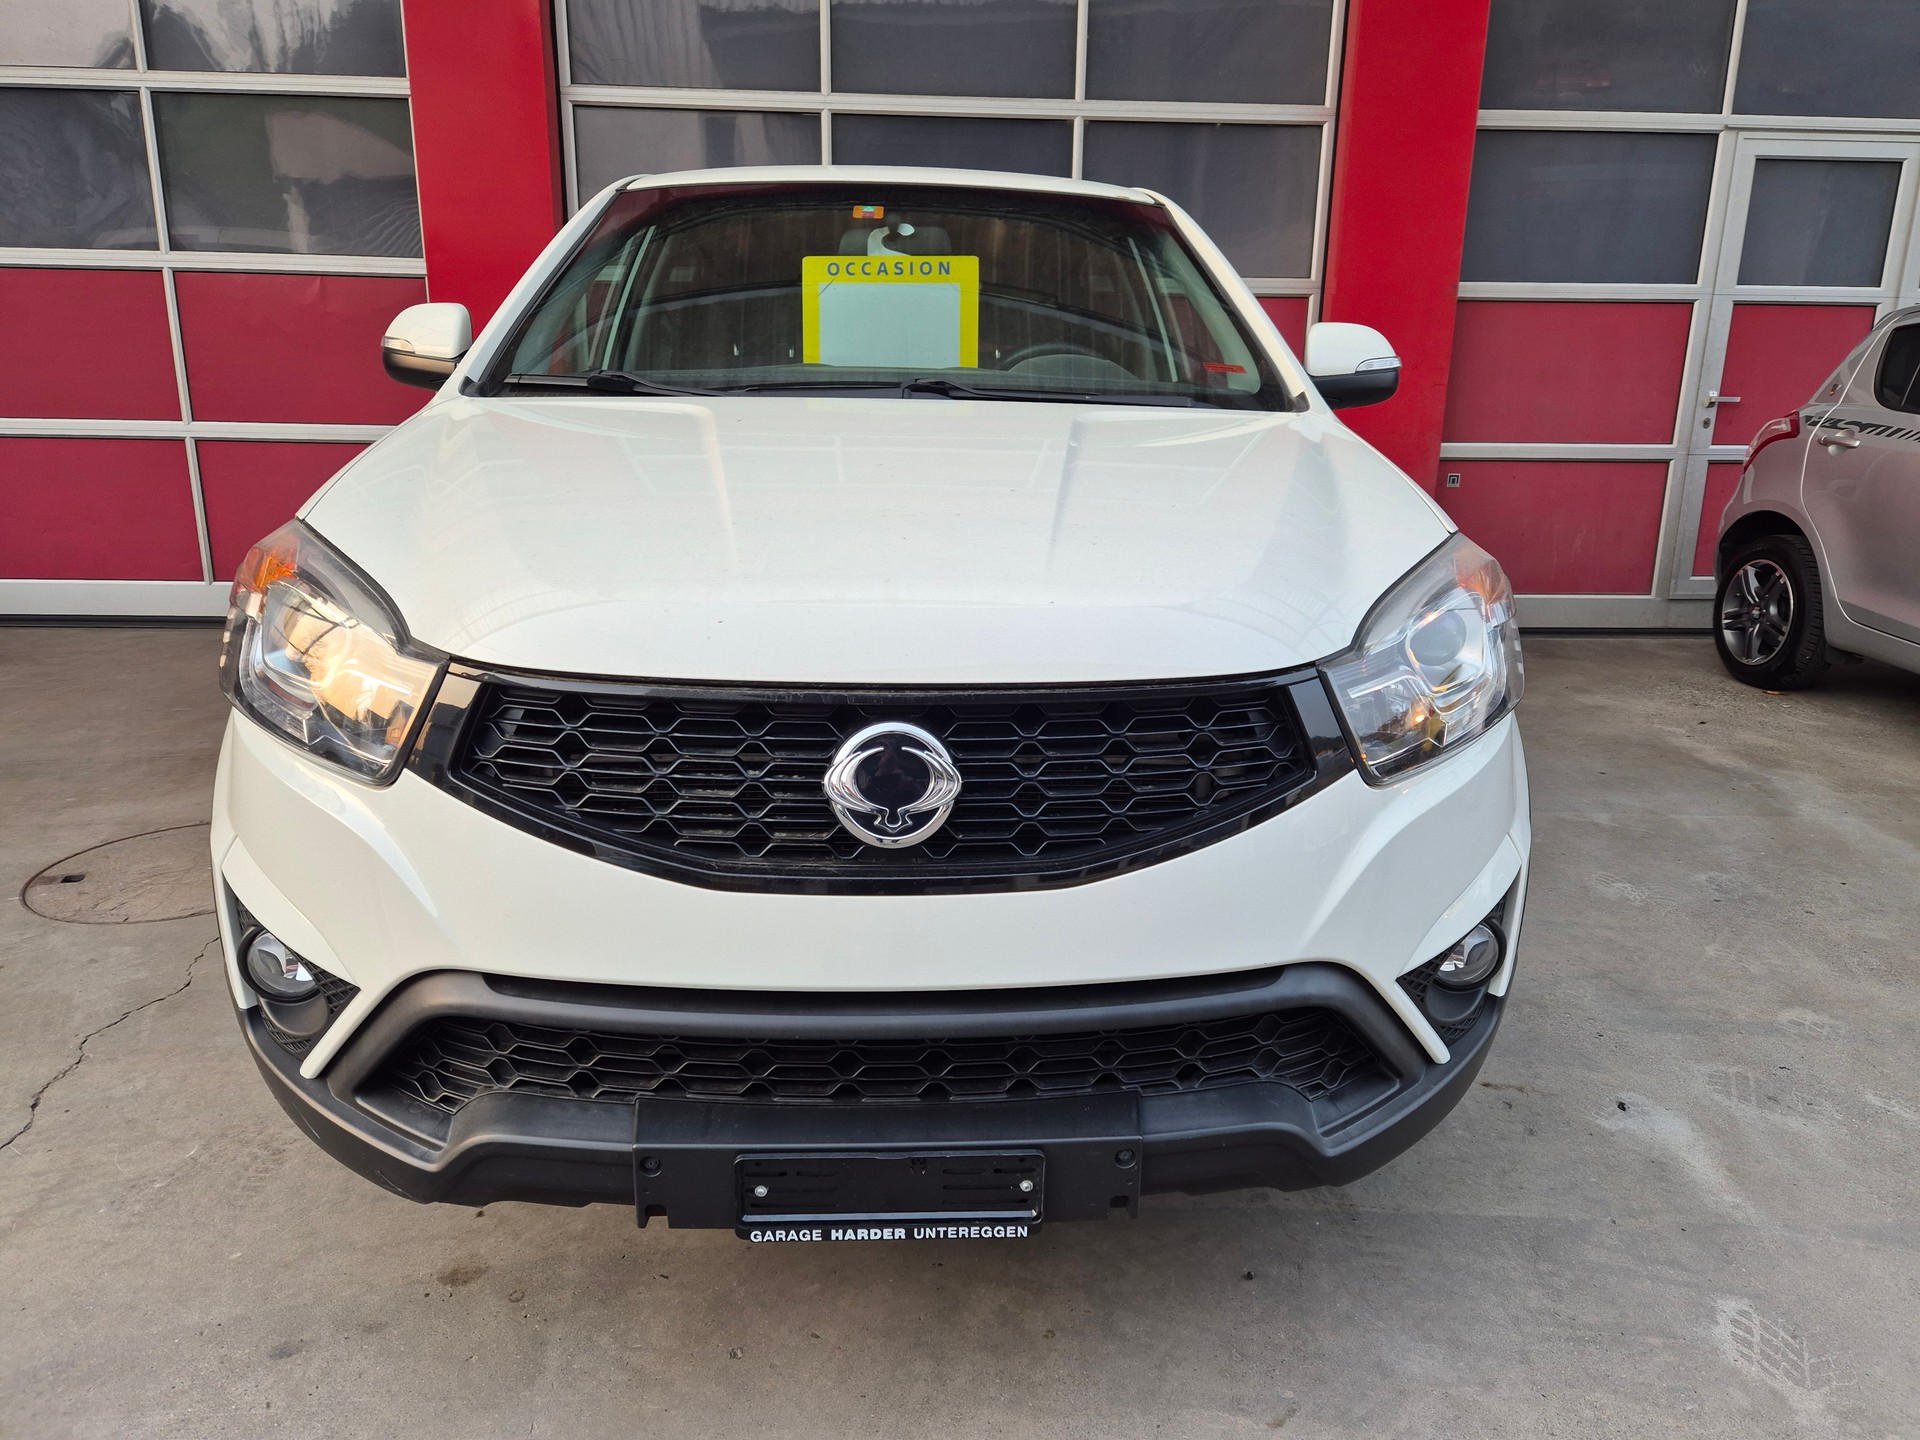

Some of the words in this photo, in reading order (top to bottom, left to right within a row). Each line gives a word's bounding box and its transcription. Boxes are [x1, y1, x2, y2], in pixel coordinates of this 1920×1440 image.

[826, 261, 950, 276] OCCASION
[750, 1230, 823, 1243] GARAGE
[831, 1228, 906, 1242] HARDER
[914, 1226, 1028, 1240] UNTEREGGEN
